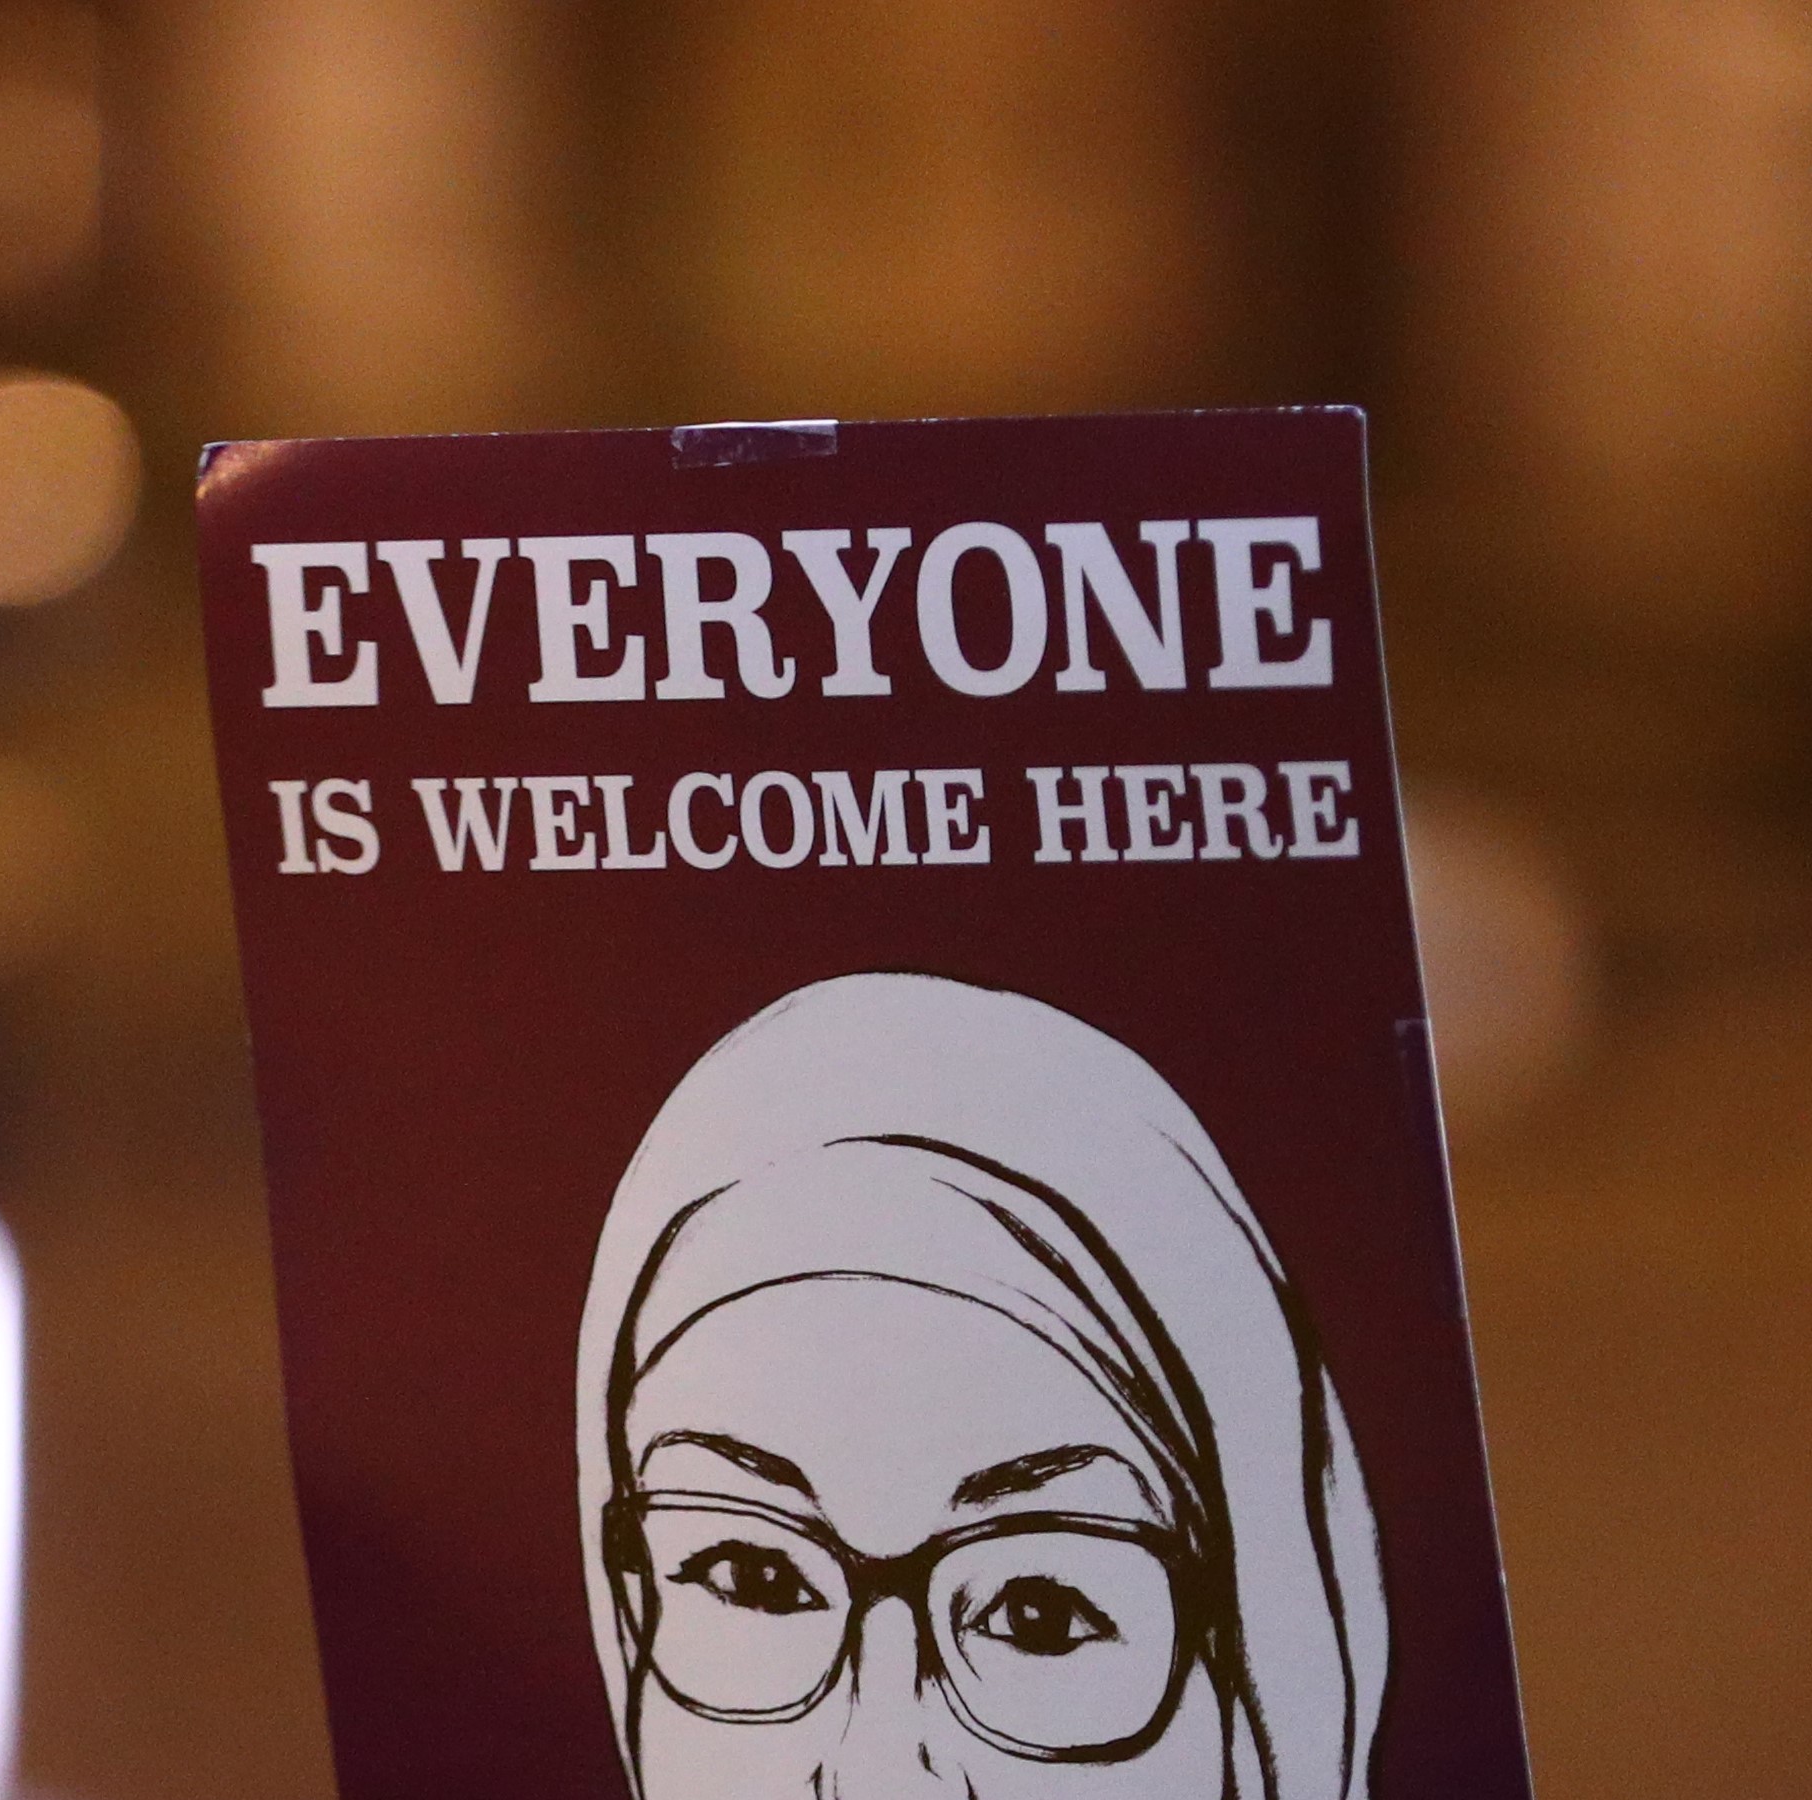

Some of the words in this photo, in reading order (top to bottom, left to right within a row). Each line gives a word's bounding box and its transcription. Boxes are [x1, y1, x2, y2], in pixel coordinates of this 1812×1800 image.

[249, 515, 1334, 709] EVERYONE
[267, 777, 381, 876] IS
[410, 767, 992, 873] WELCOME
[1024, 759, 1361, 864] HERE
